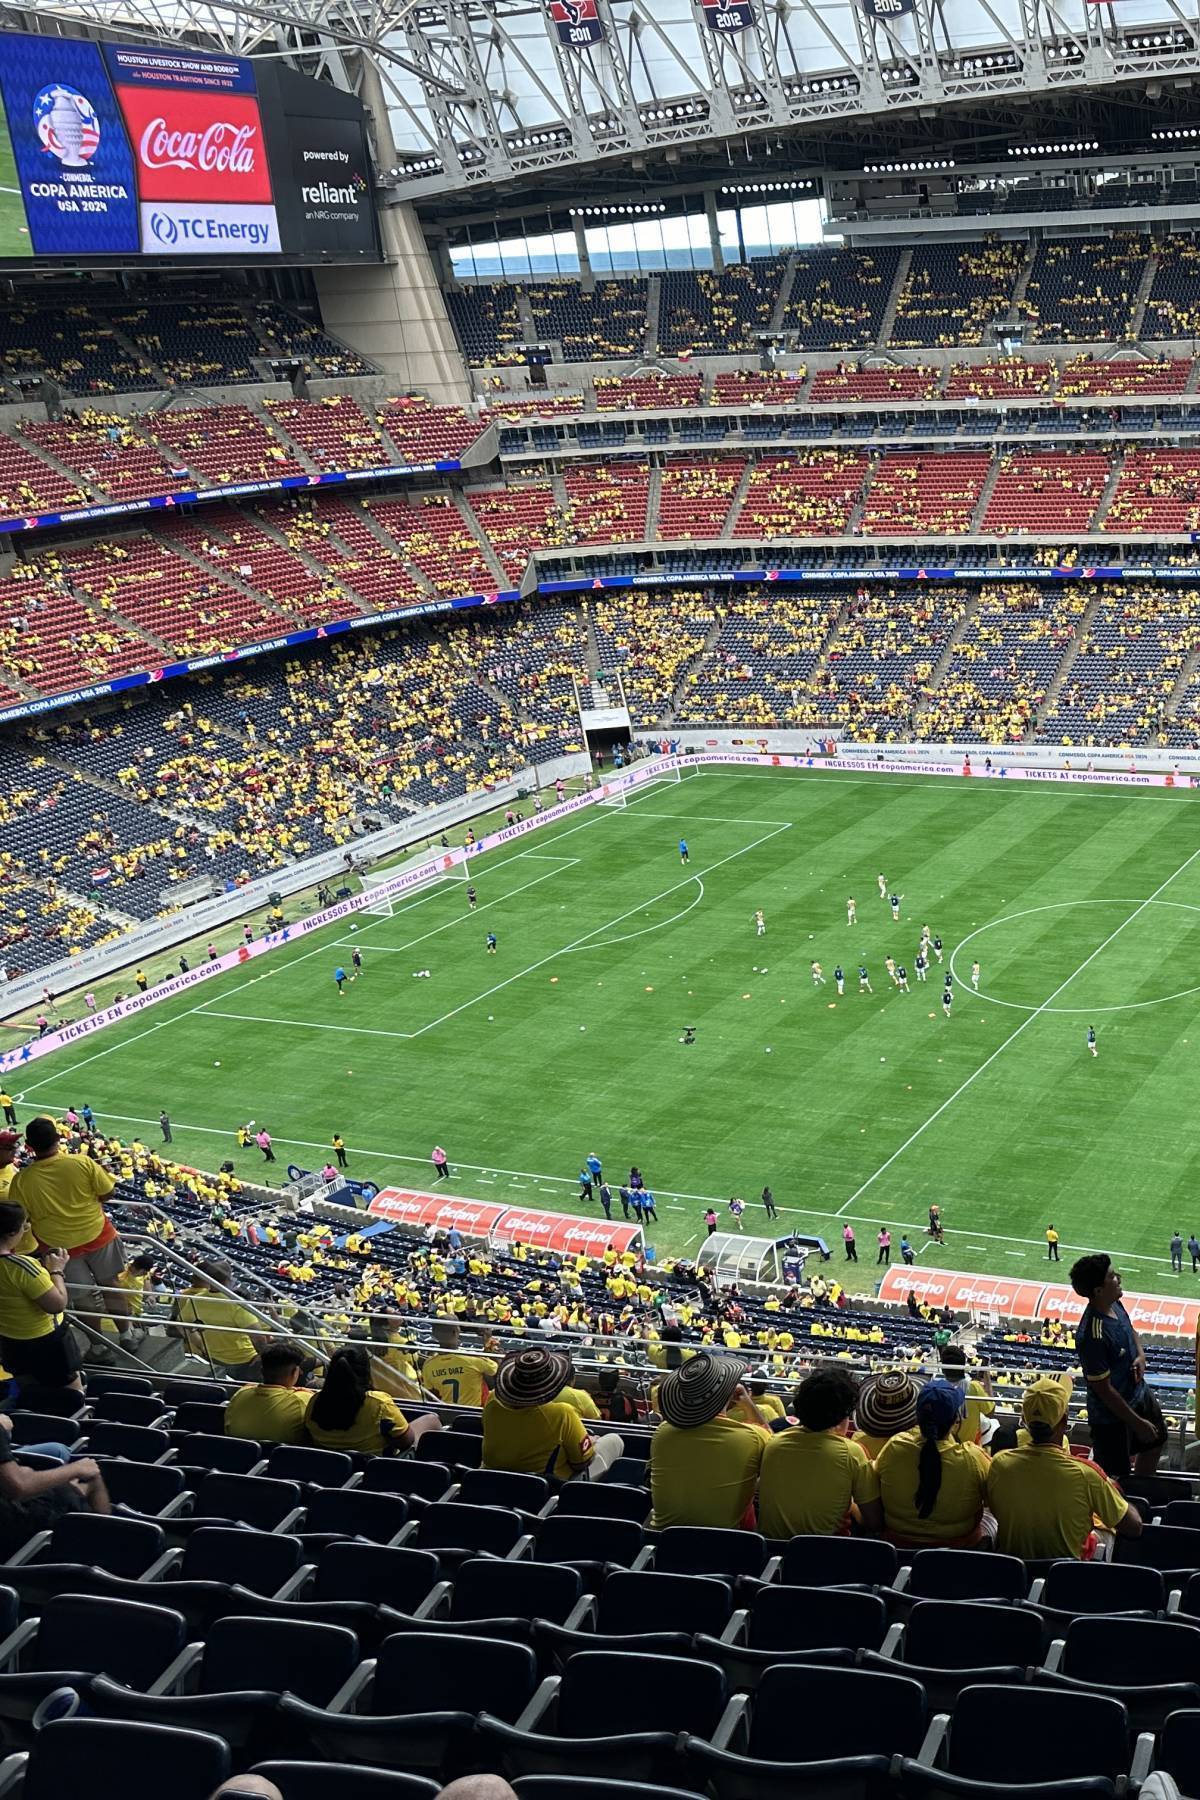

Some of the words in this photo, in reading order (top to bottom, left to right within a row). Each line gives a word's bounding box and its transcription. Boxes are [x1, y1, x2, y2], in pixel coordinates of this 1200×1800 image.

[716, 13, 742, 28] 2012
[569, 27, 591, 42] 2011
[117, 54, 148, 65] HOUSTON
[149, 58, 180, 68] LIVESTOCK
[181, 61, 200, 70] SHOW
[201, 63, 213, 71] AND
[141, 118, 256, 172] Coca-Cola
[304, 151, 338, 161] powered
[339, 151, 349, 163] by
[30, 184, 67, 197] COPA
[69, 185, 128, 199] AMERICA
[302, 182, 358, 203] reliant
[58, 201, 79, 212] USA
[83, 201, 107, 212] 2024
[314, 211, 329, 219] NRG
[331, 213, 359, 222] company
[179, 219, 202, 238] TC
[207, 220, 269, 243] Energy
[825, 761, 867, 770] INGRESSOS
[868, 762, 879, 770] EM
[1025, 770, 1057, 779] TICKETS
[498, 823, 525, 841] TICKETS
[526, 820, 535, 831] AT
[302, 905, 348, 931] INGRESSOS
[350, 898, 363, 909] EM
[58, 1015, 105, 1043] TICKETS
[107, 1006, 123, 1020] EN
[379, 1198, 421, 1213] Betano
[437, 1206, 480, 1222] Betano
[506, 1218, 549, 1233] Betano
[565, 1227, 611, 1242] Betano
[892, 1277, 945, 1295] Betano
[956, 1288, 1009, 1306] Betano
[1046, 1298, 1086, 1313] Beta
[1131, 1309, 1184, 1327] Betano
[448, 1367, 464, 1375] DIAZ
[442, 1379, 459, 1404] 7
